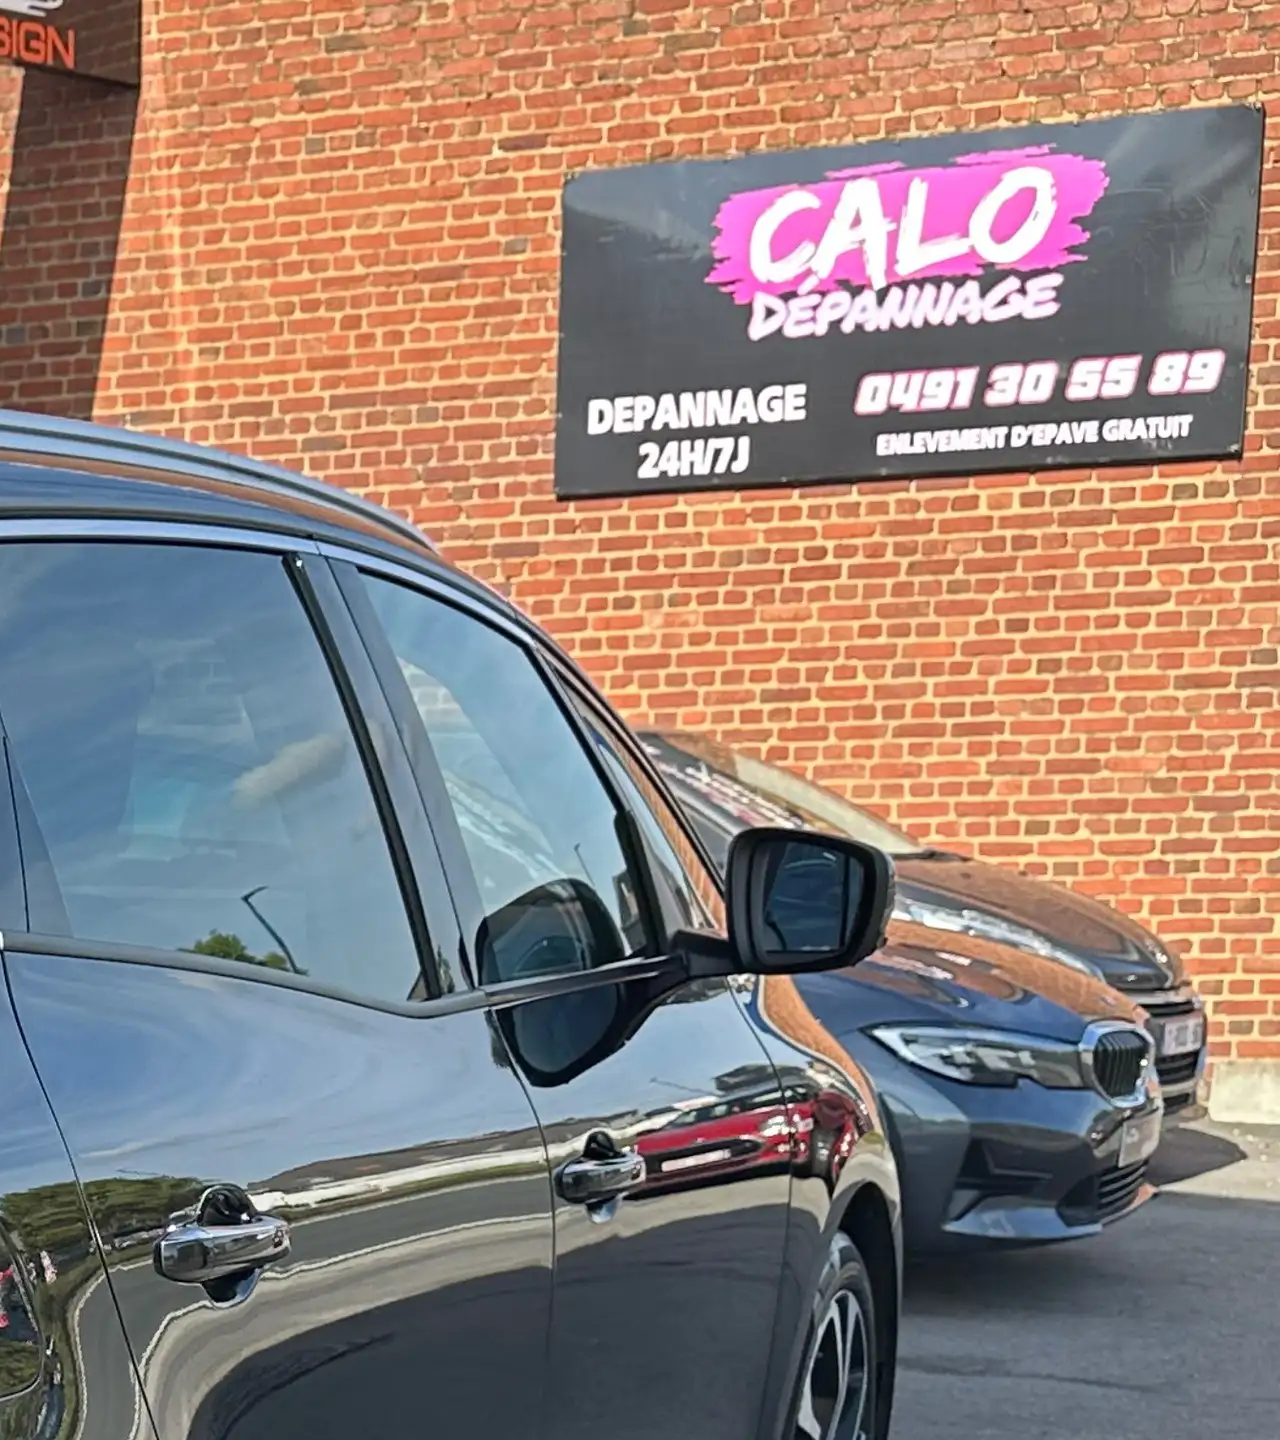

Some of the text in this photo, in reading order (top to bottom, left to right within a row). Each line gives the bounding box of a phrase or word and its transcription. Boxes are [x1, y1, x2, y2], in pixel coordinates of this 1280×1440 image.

[749, 165, 1058, 291] CALO
[747, 272, 1065, 342] DÉPANNAGE
[586, 382, 808, 436] DEPANNAGE
[853, 348, 1227, 416] 0491 30 55 89
[636, 435, 751, 479] 24H/7J
[875, 413, 1195, 457] ENLEVEMENT D'EPAVE GRATUIT
